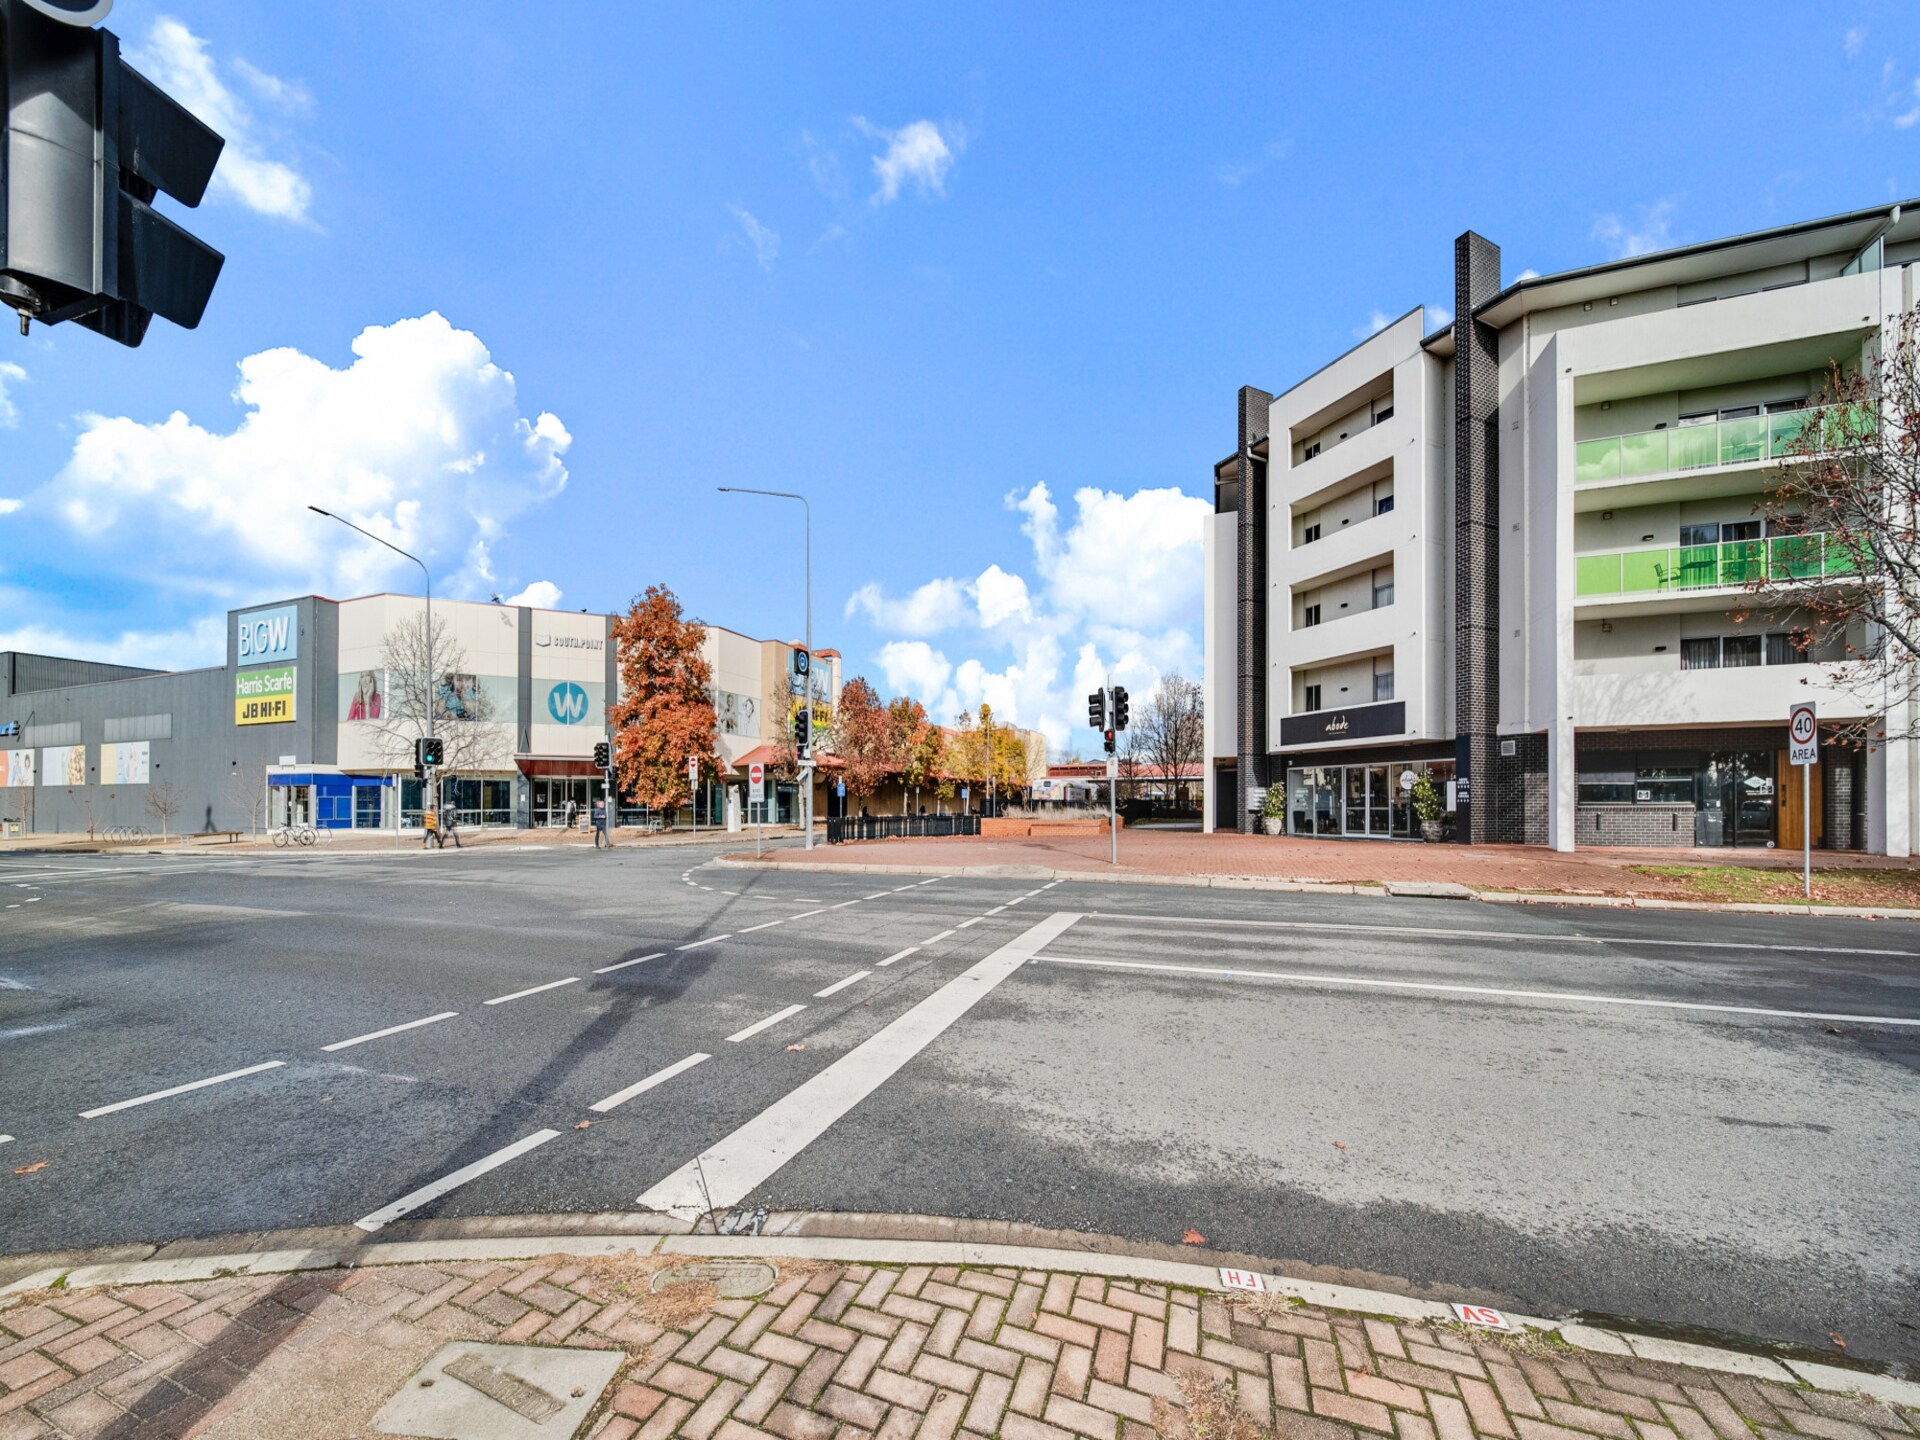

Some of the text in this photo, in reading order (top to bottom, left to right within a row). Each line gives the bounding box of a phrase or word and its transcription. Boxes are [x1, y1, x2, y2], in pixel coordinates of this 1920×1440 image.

[236, 671, 292, 694] Harris Scarfe
[242, 703, 258, 719] JB
[1325, 714, 1349, 731] abode
[1794, 717, 1812, 734] 40
[1791, 748, 1816, 761] AREA
[1227, 1270, 1256, 1288] FH
[1462, 1305, 1500, 1325] SV
